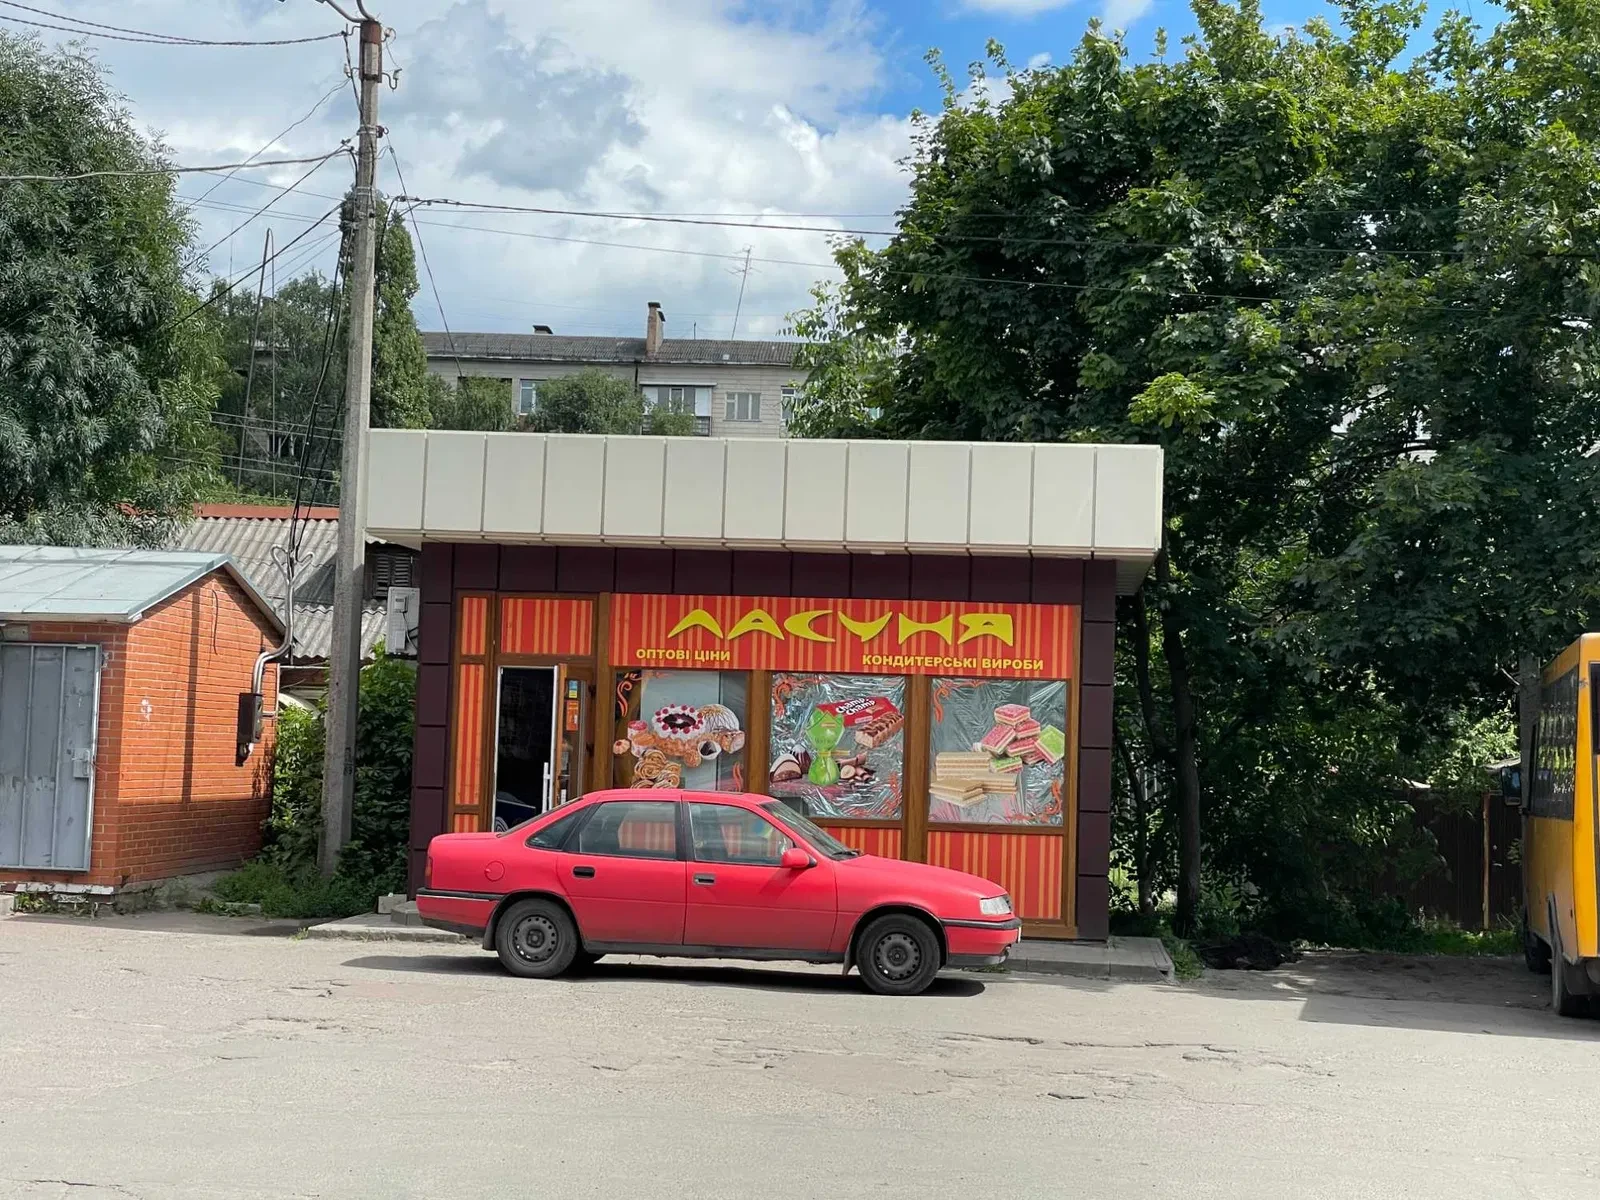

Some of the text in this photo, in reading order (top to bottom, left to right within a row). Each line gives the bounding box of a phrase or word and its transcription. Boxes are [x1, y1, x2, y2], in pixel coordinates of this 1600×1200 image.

[667, 608, 1013, 647] ЛАСУНЯ
[636, 648, 731, 662] ОПТОВІ ЦІНИ
[862, 654, 1044, 671] КОНДИТЕРСЬКІ ВИРОБИ
[846, 700, 876, 716] Champ
